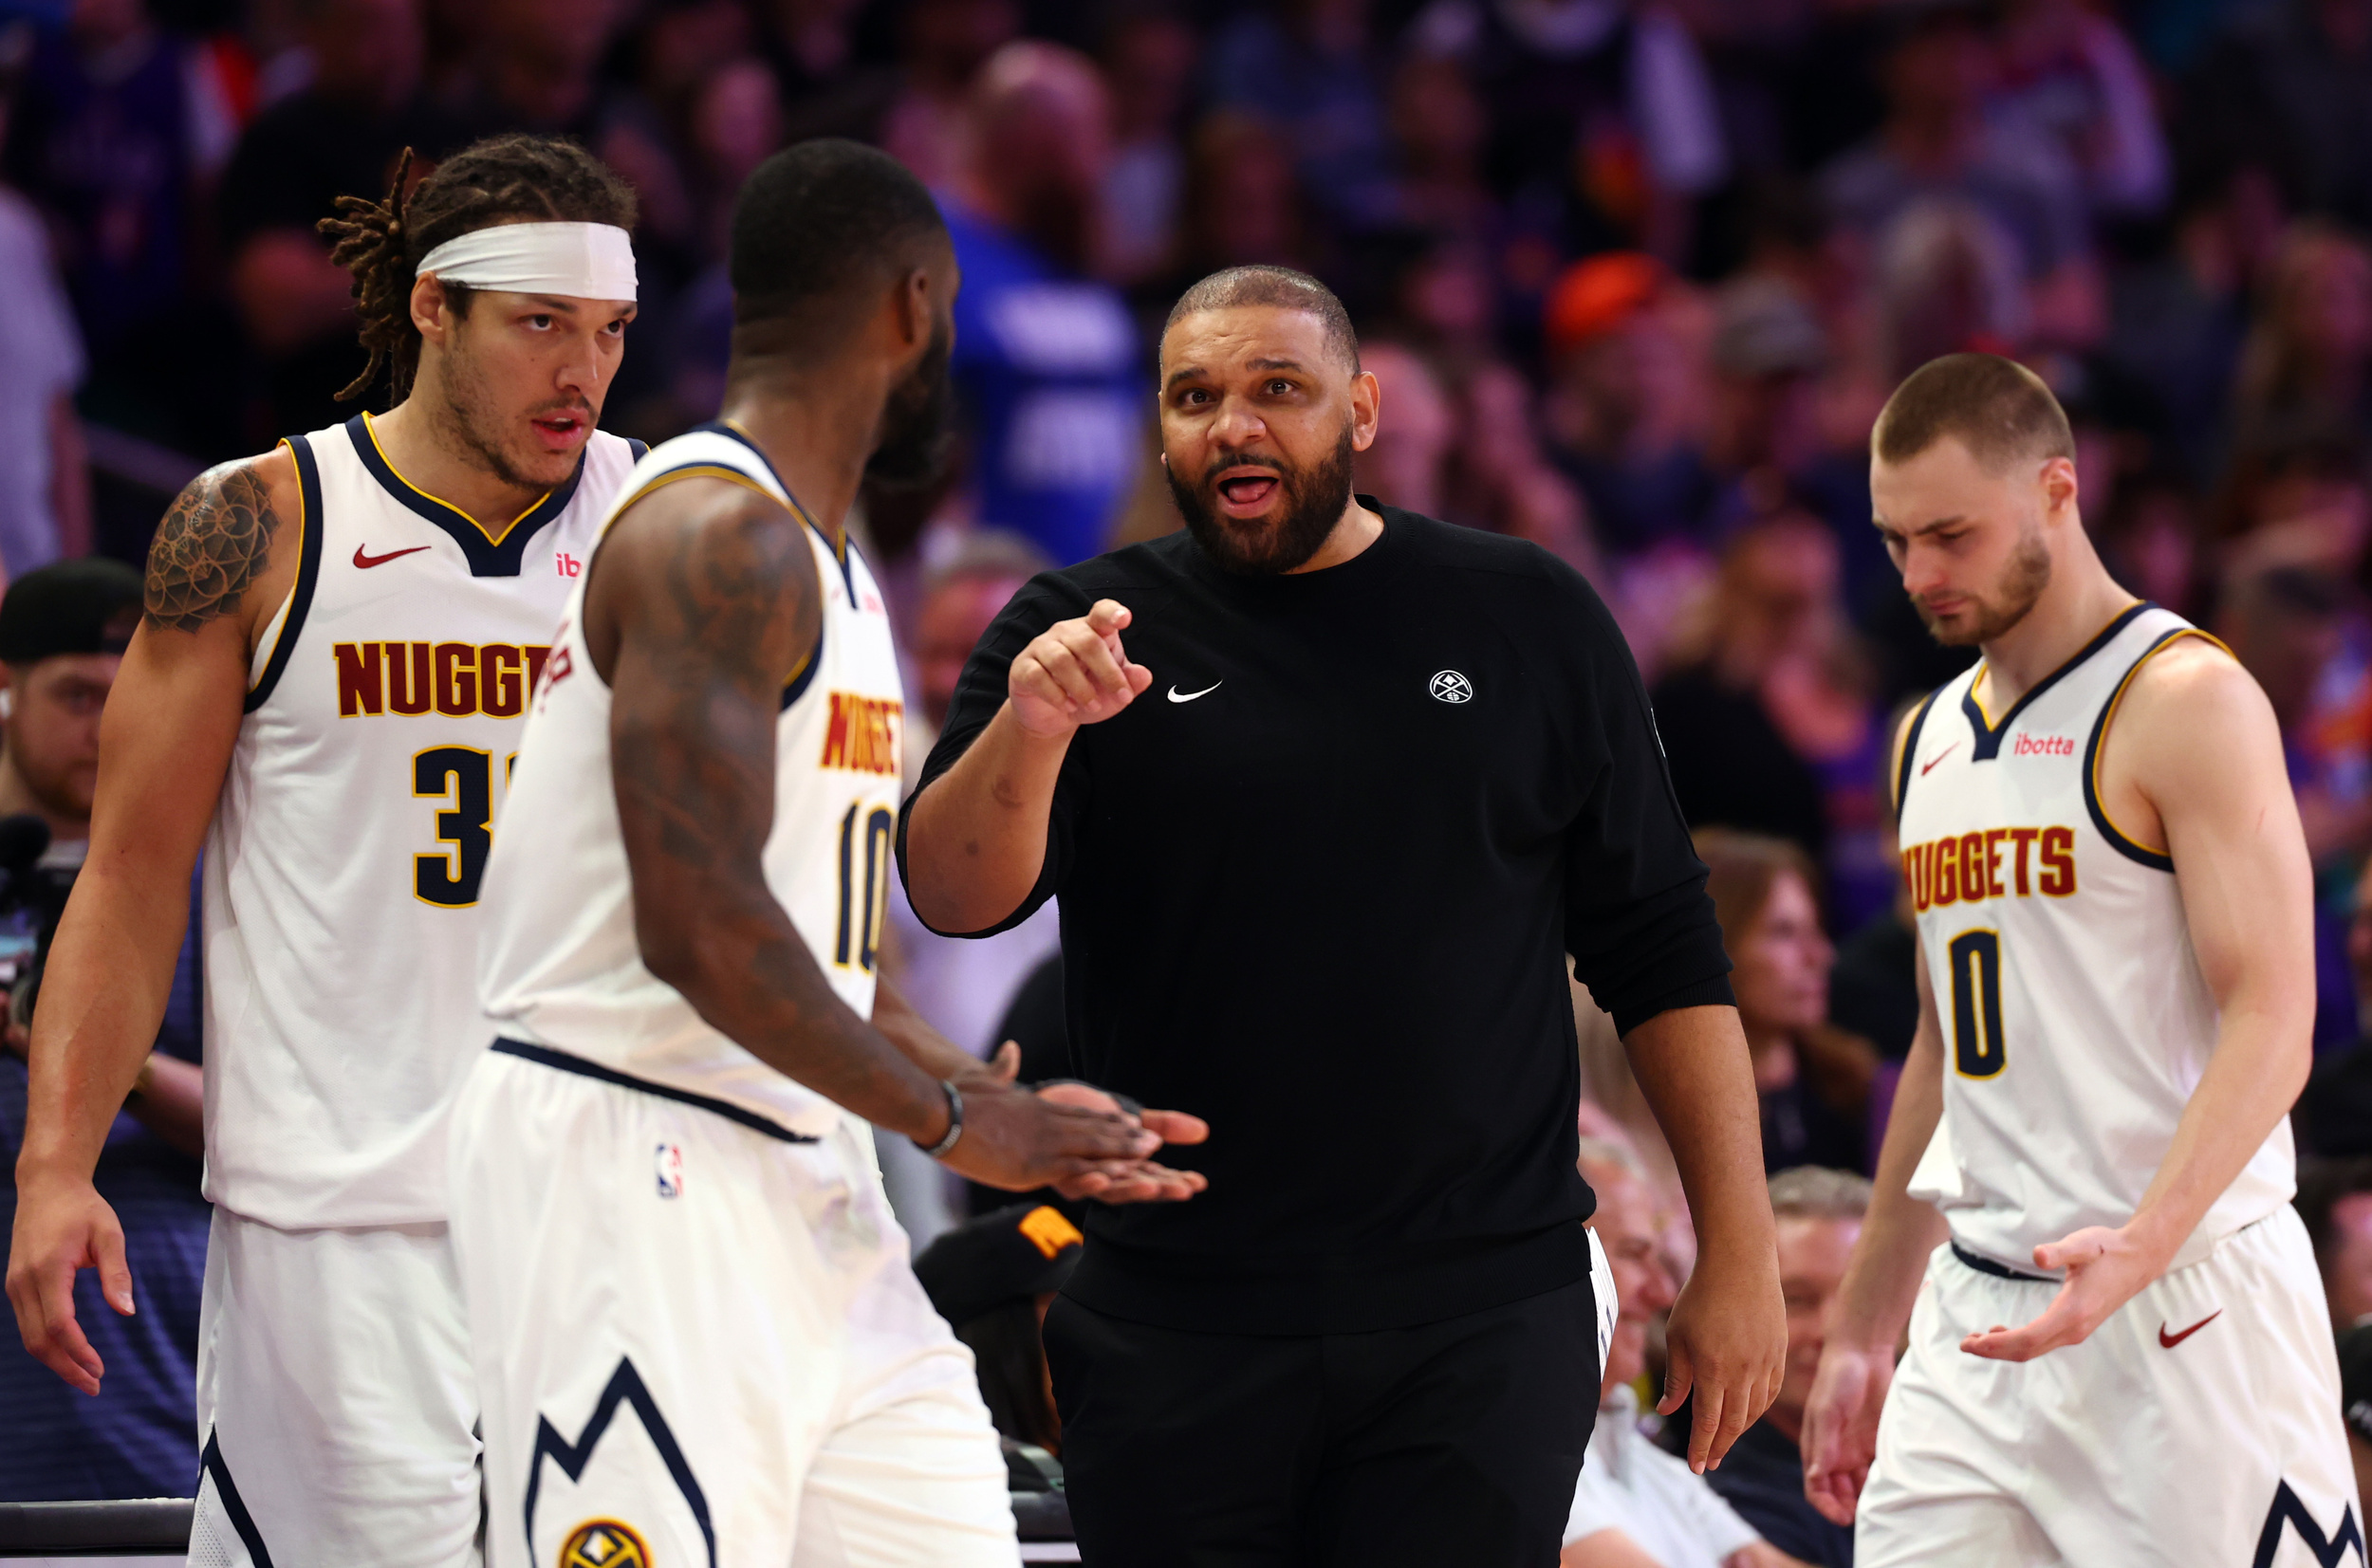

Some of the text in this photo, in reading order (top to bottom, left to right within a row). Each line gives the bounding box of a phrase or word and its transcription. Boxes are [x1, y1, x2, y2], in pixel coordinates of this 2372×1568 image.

[2013, 731, 2075, 756] ibotta
[412, 744, 522, 909] 3
[834, 798, 898, 976] 10
[1948, 926, 2008, 1080] 0
